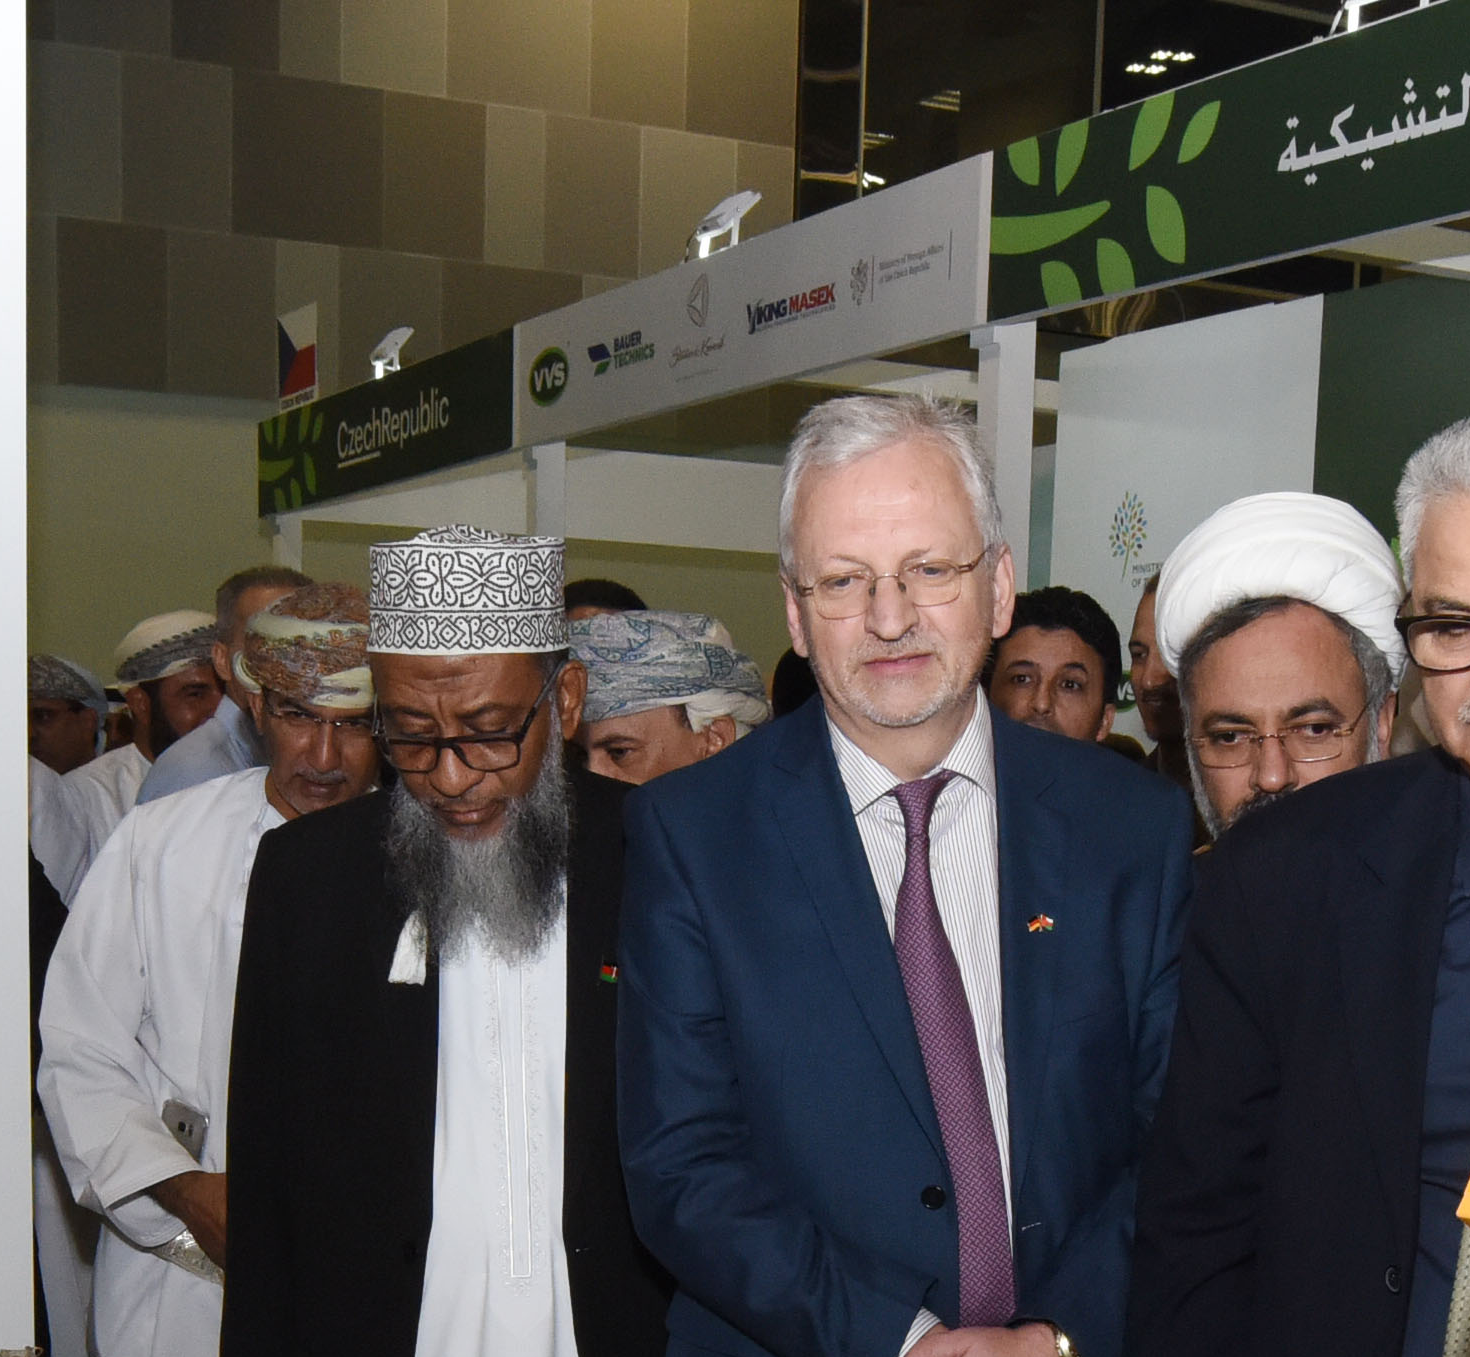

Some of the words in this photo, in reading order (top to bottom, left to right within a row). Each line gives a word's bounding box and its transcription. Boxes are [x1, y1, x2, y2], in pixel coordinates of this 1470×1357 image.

[747, 299, 787, 335] VIKING
[788, 282, 836, 316] MASEK
[613, 330, 642, 353] BAUER
[614, 343, 655, 370] TECHNICS
[534, 361, 565, 392] VVS
[337, 388, 450, 459] CzechRepublic
[1132, 563, 1161, 574] MINISTR
[1117, 682, 1136, 701] VS
